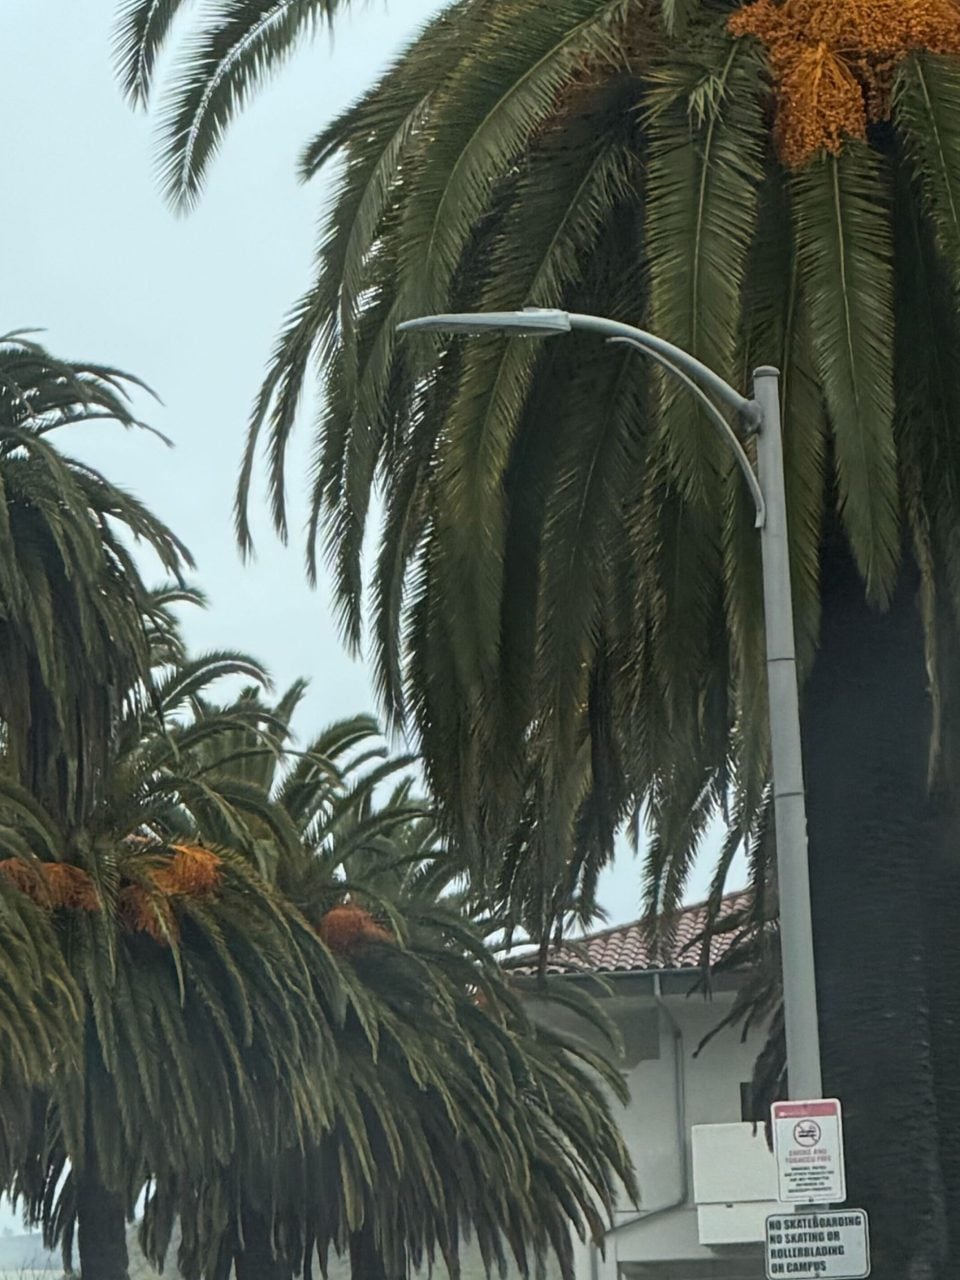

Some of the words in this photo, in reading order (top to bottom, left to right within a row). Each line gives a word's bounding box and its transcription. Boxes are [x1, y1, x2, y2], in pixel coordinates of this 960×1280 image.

[769, 1220, 781, 1230] NO
[783, 1216, 861, 1230] SKATEBOARDING
[770, 1235, 782, 1244] NO
[785, 1231, 825, 1243] SKATING
[827, 1231, 840, 1241] OR
[771, 1245, 845, 1259] ROLLERBLADING
[771, 1263, 784, 1274] ON
[787, 1261, 826, 1273] CAMPUS
